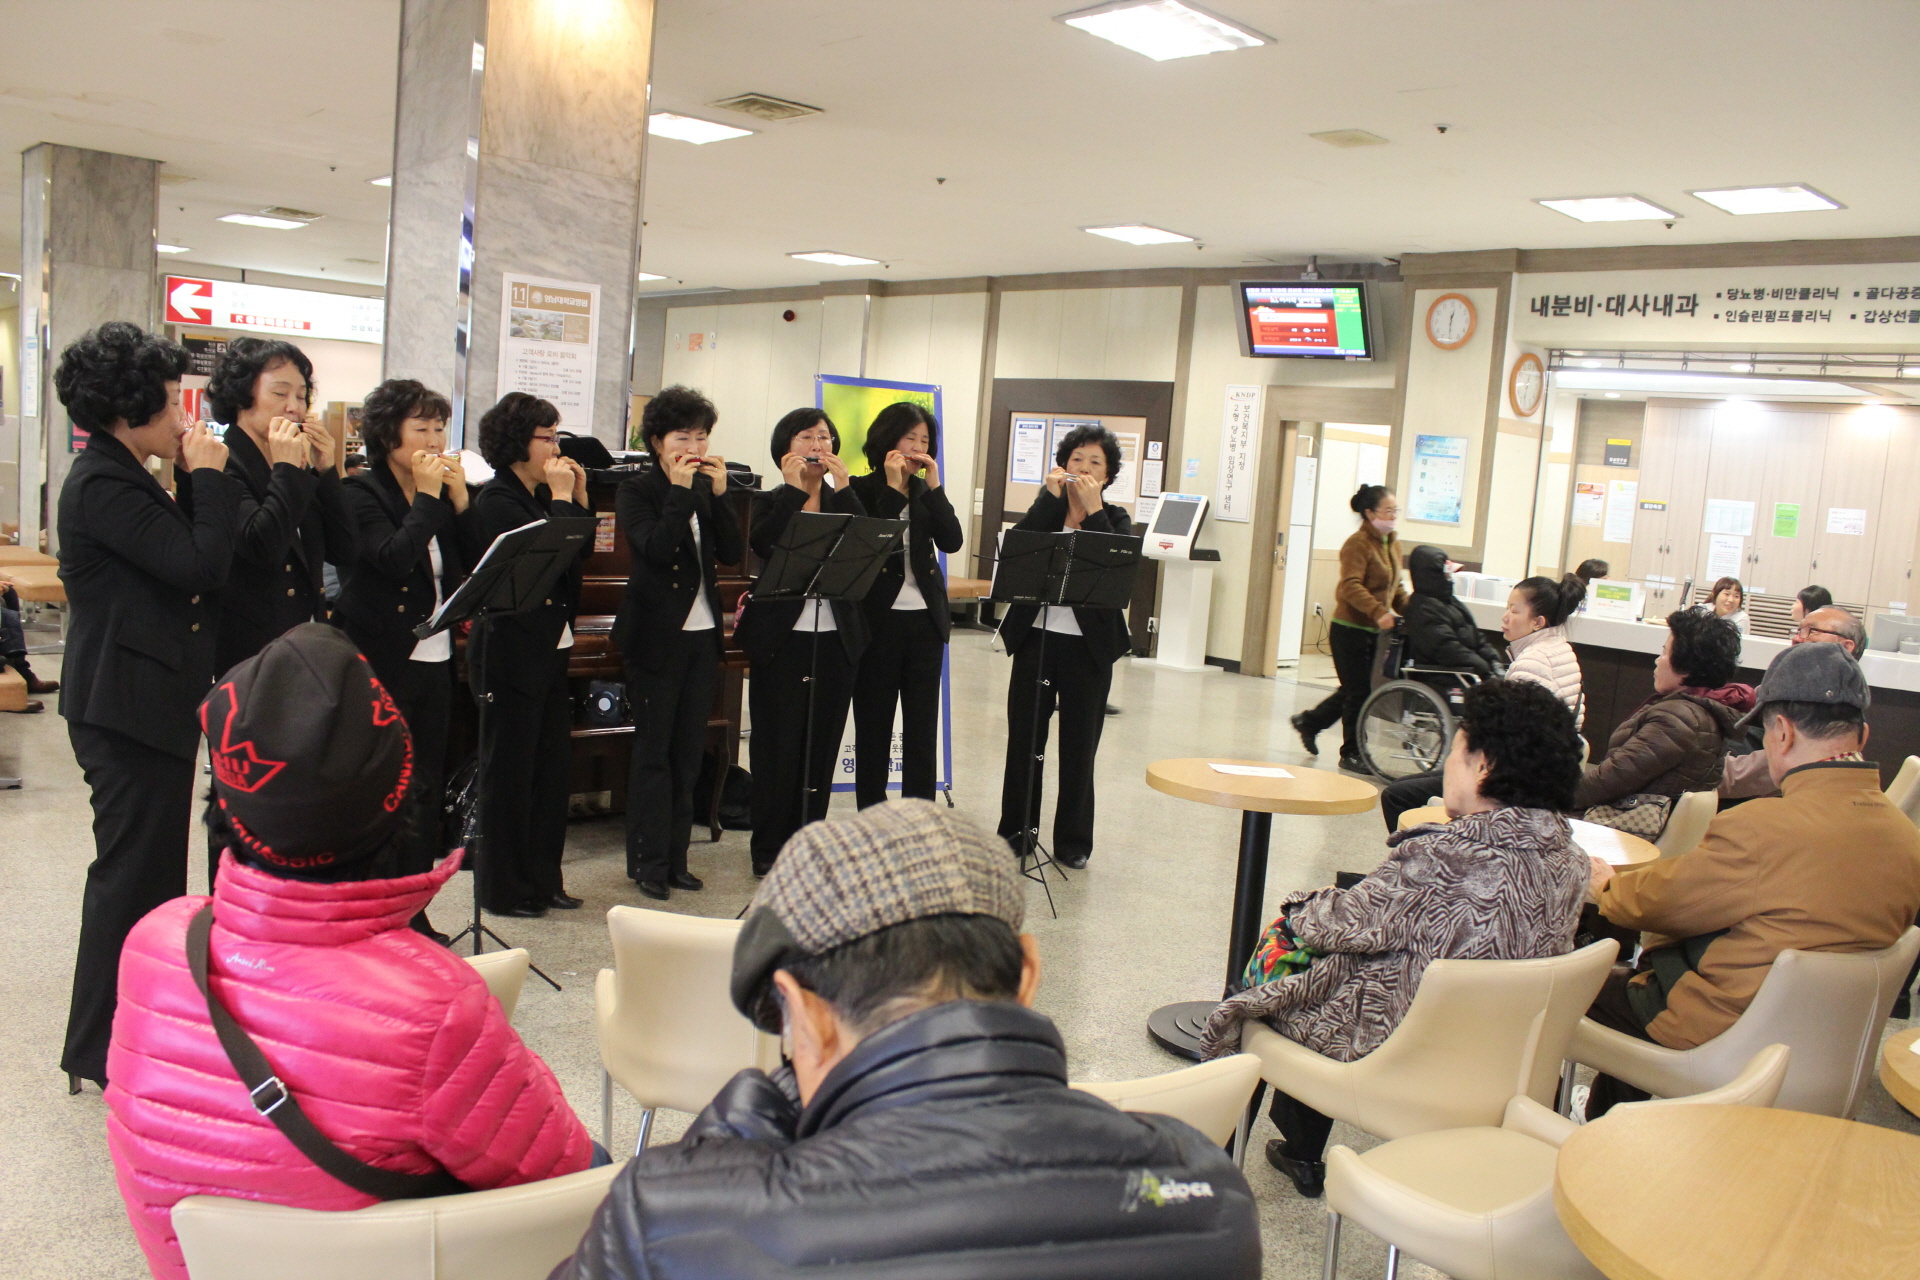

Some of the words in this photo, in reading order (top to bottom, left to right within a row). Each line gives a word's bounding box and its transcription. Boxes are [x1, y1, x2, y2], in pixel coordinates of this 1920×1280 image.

[513, 286, 526, 301] 11
[544, 294, 588, 308] 영남대학교병원
[1726, 287, 1839, 301] 당뇨병·비만클리닉
[1530, 293, 1700, 317] 내분비·대사내과
[1725, 309, 1832, 323] 인슐린펌프클리닉
[522, 348, 545, 357] 고객사랑
[1232, 404, 1239, 422] 2형
[1240, 404, 1250, 449] 보건복지부
[1230, 425, 1238, 453] 당뇨병
[1238, 452, 1246, 471] 지정
[1225, 455, 1235, 491] 임상연구
[1224, 494, 1231, 513] 센터
